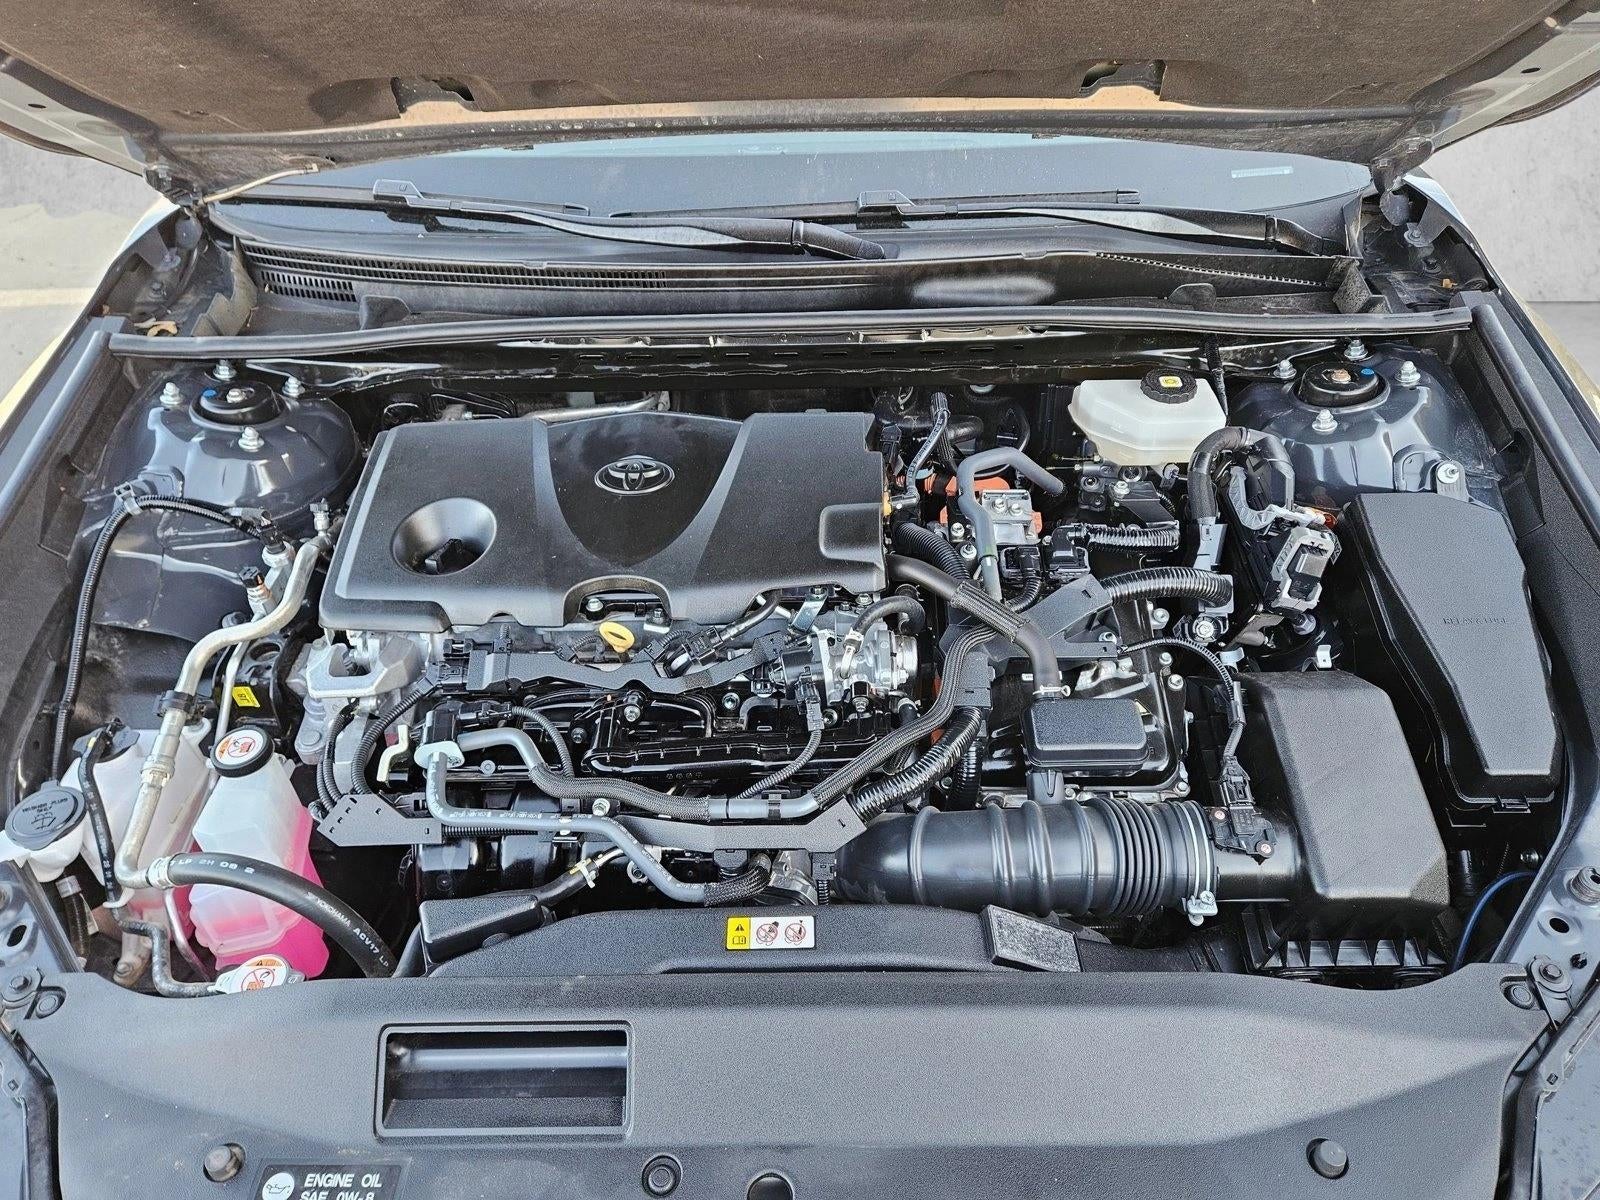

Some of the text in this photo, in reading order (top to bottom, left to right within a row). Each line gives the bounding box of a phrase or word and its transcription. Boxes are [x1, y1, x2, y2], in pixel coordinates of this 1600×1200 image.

[303, 1173, 383, 1188] ENGINE OIL
[299, 1190, 329, 1200] SAE
